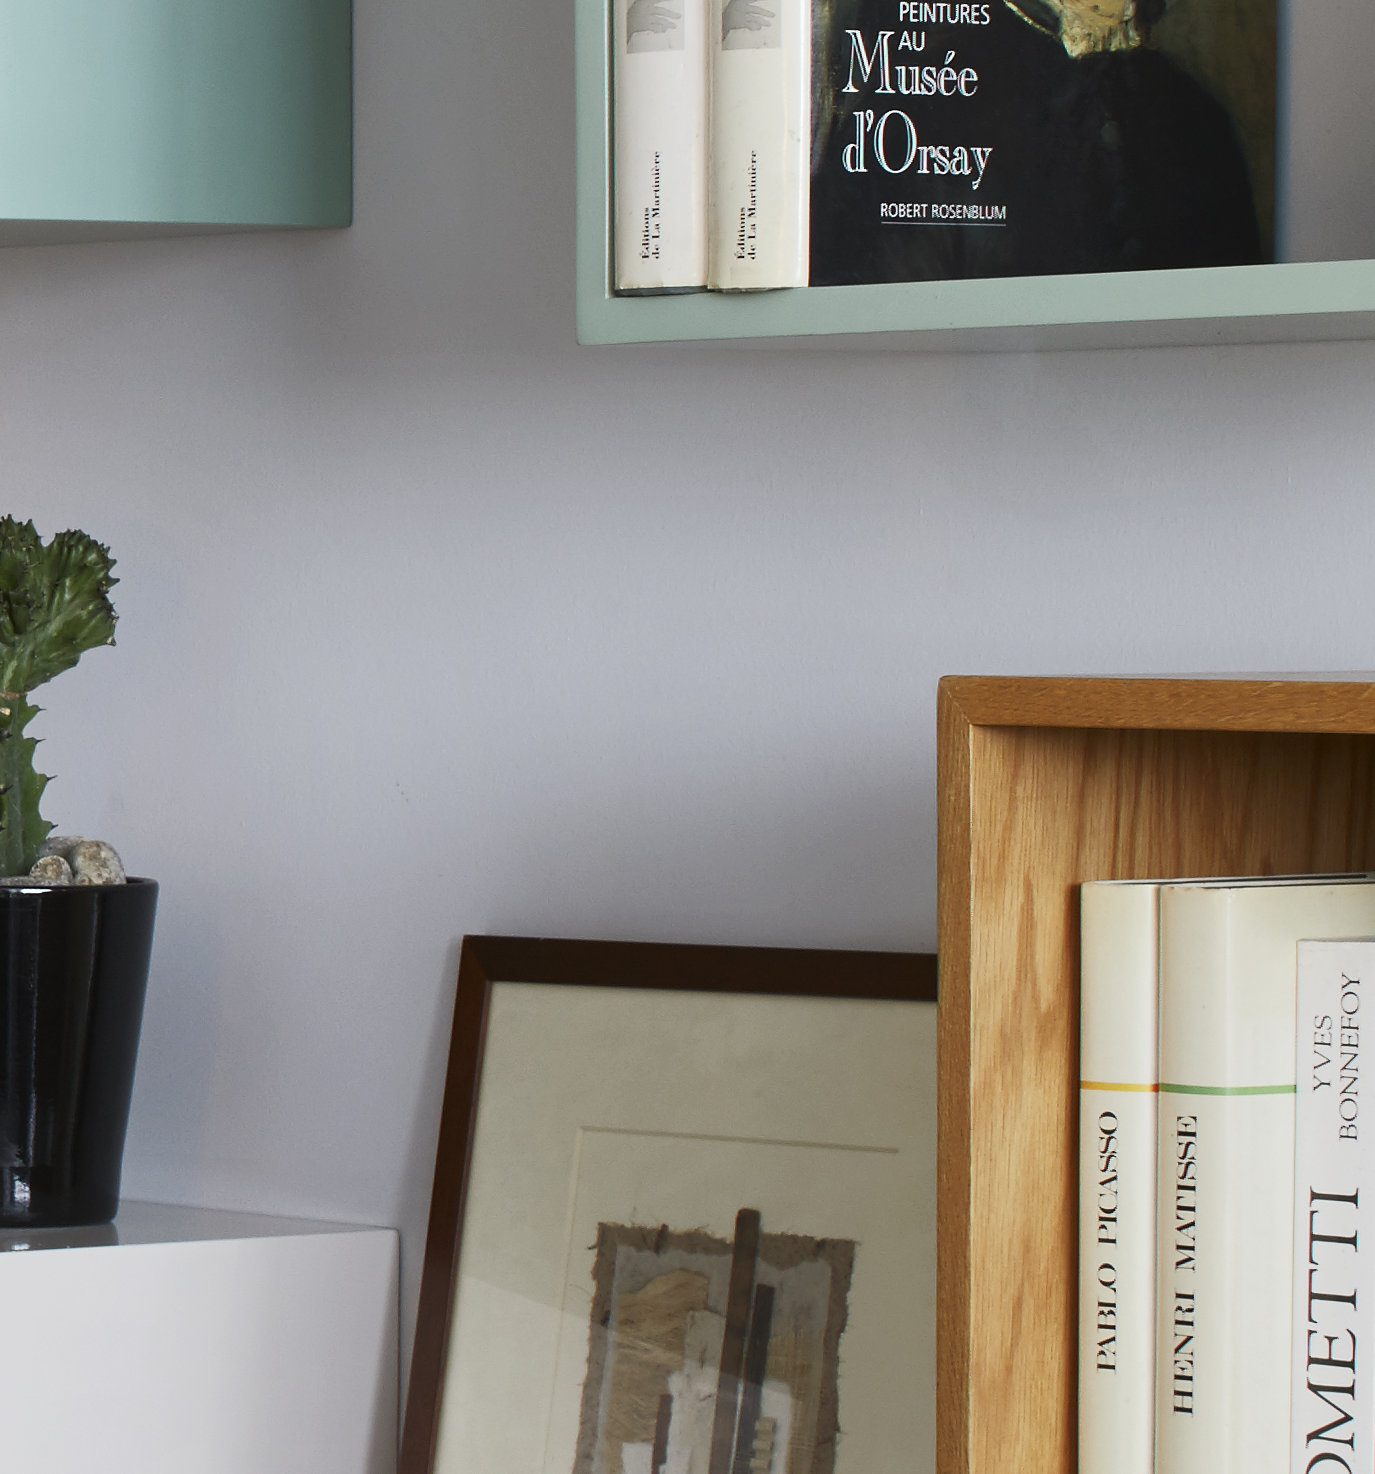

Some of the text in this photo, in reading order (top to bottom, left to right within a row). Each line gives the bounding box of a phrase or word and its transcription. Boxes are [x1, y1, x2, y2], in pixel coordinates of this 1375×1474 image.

[897, 30, 926, 52] AU
[899, 1, 991, 25] PEINTURES
[841, 29, 979, 97] Musée
[841, 108, 994, 191] d'Orsay
[639, 206, 650, 260] Éditions
[651, 151, 661, 260] de La Martinière
[734, 206, 746, 260] Éditions
[747, 150, 757, 260] de La Martinière
[880, 202, 1007, 220] ROBERT ROSENBLUM
[1312, 1014, 1333, 1094] YVES
[1338, 972, 1361, 1142] BONNEFOY
[1096, 1110, 1119, 1375] PABLO PICASSO
[1173, 1114, 1198, 1419] HENRI MATISSE
